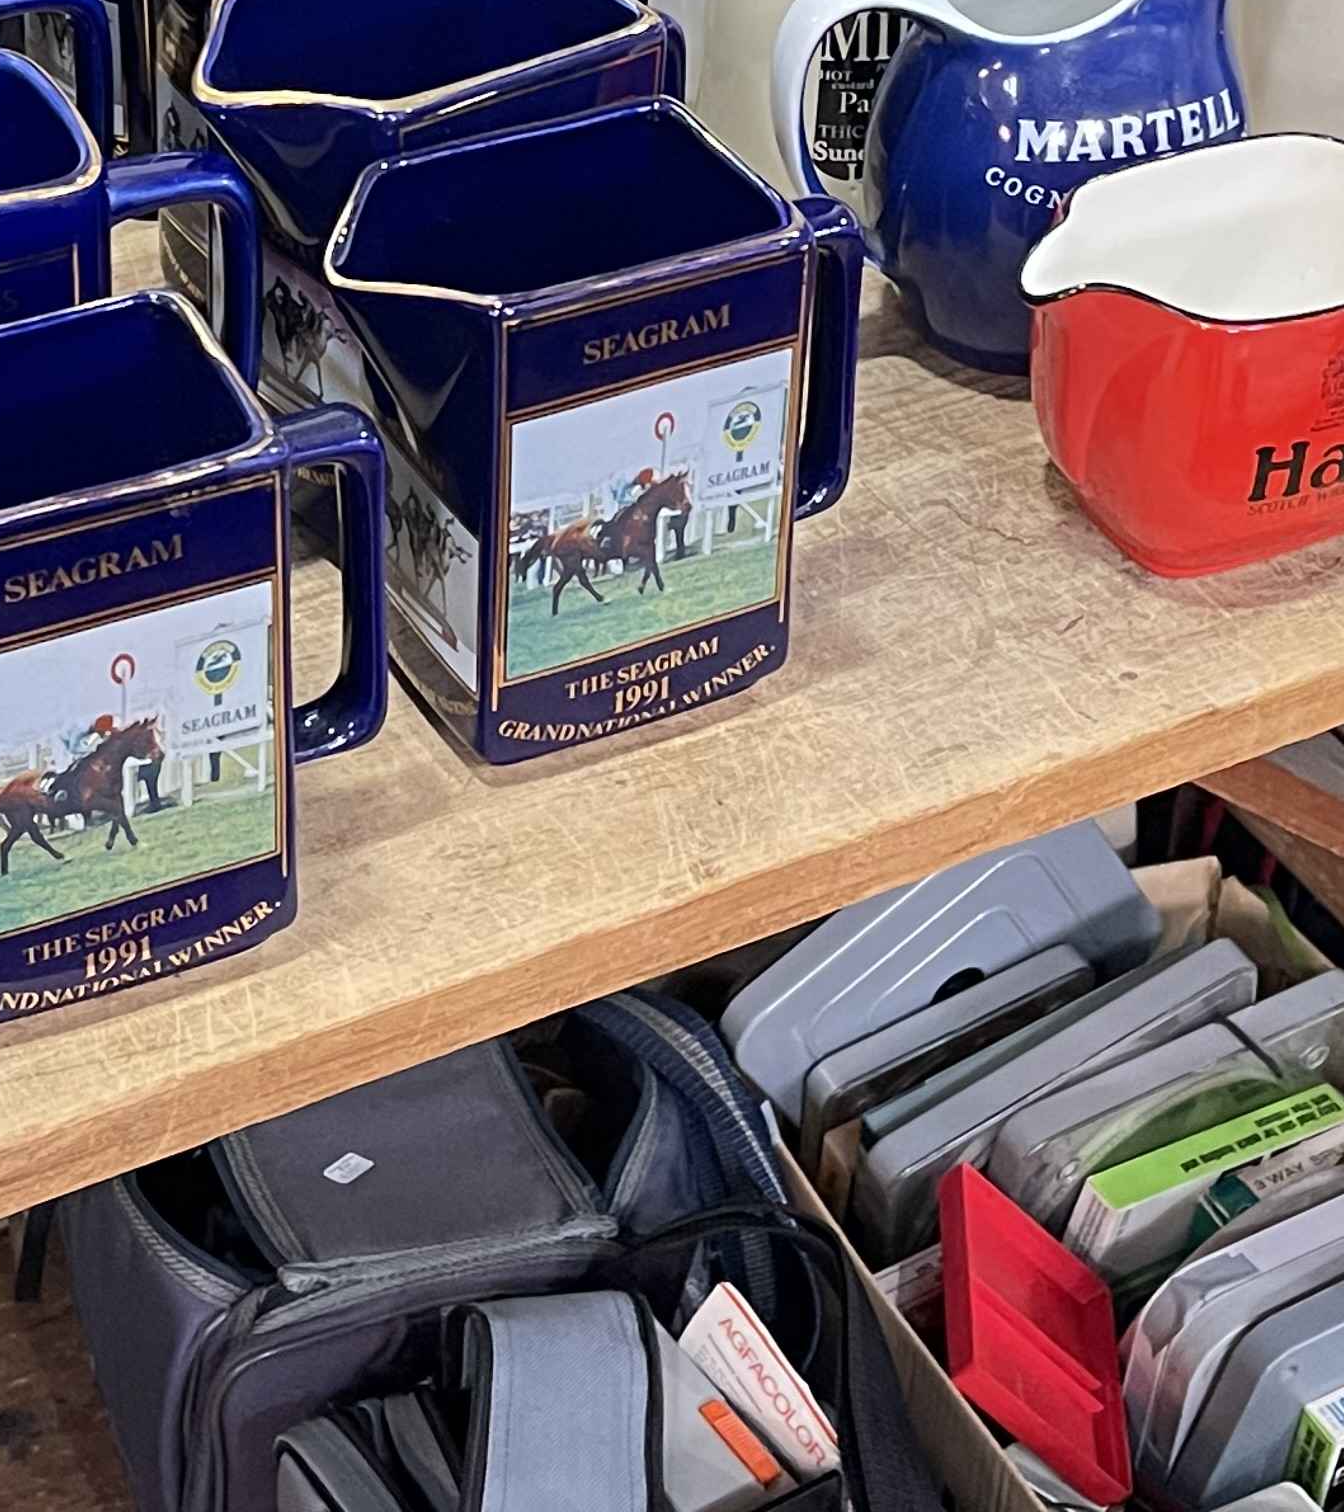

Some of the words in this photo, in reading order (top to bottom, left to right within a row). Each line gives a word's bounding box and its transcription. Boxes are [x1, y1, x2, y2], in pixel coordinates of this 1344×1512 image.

[839, 90, 872, 115] Pa
[818, 123, 865, 140] THIC
[1014, 87, 1242, 164] MARTELL
[984, 166, 1068, 210] COGN
[581, 303, 731, 367] SEAGRAM
[706, 458, 771, 488] SEAGRAM
[3, 534, 184, 604] SEAGRAM
[565, 673, 614, 699] THE
[616, 636, 721, 686] SEAGRAM
[613, 676, 670, 715] 1991
[181, 703, 258, 736] SEAGRAM
[498, 720, 576, 742] GRAND
[22, 932, 83, 966] THE
[84, 893, 210, 949] SEAGRAM
[83, 935, 154, 979] 1991
[718, 1317, 826, 1468] AGFACOLOR
